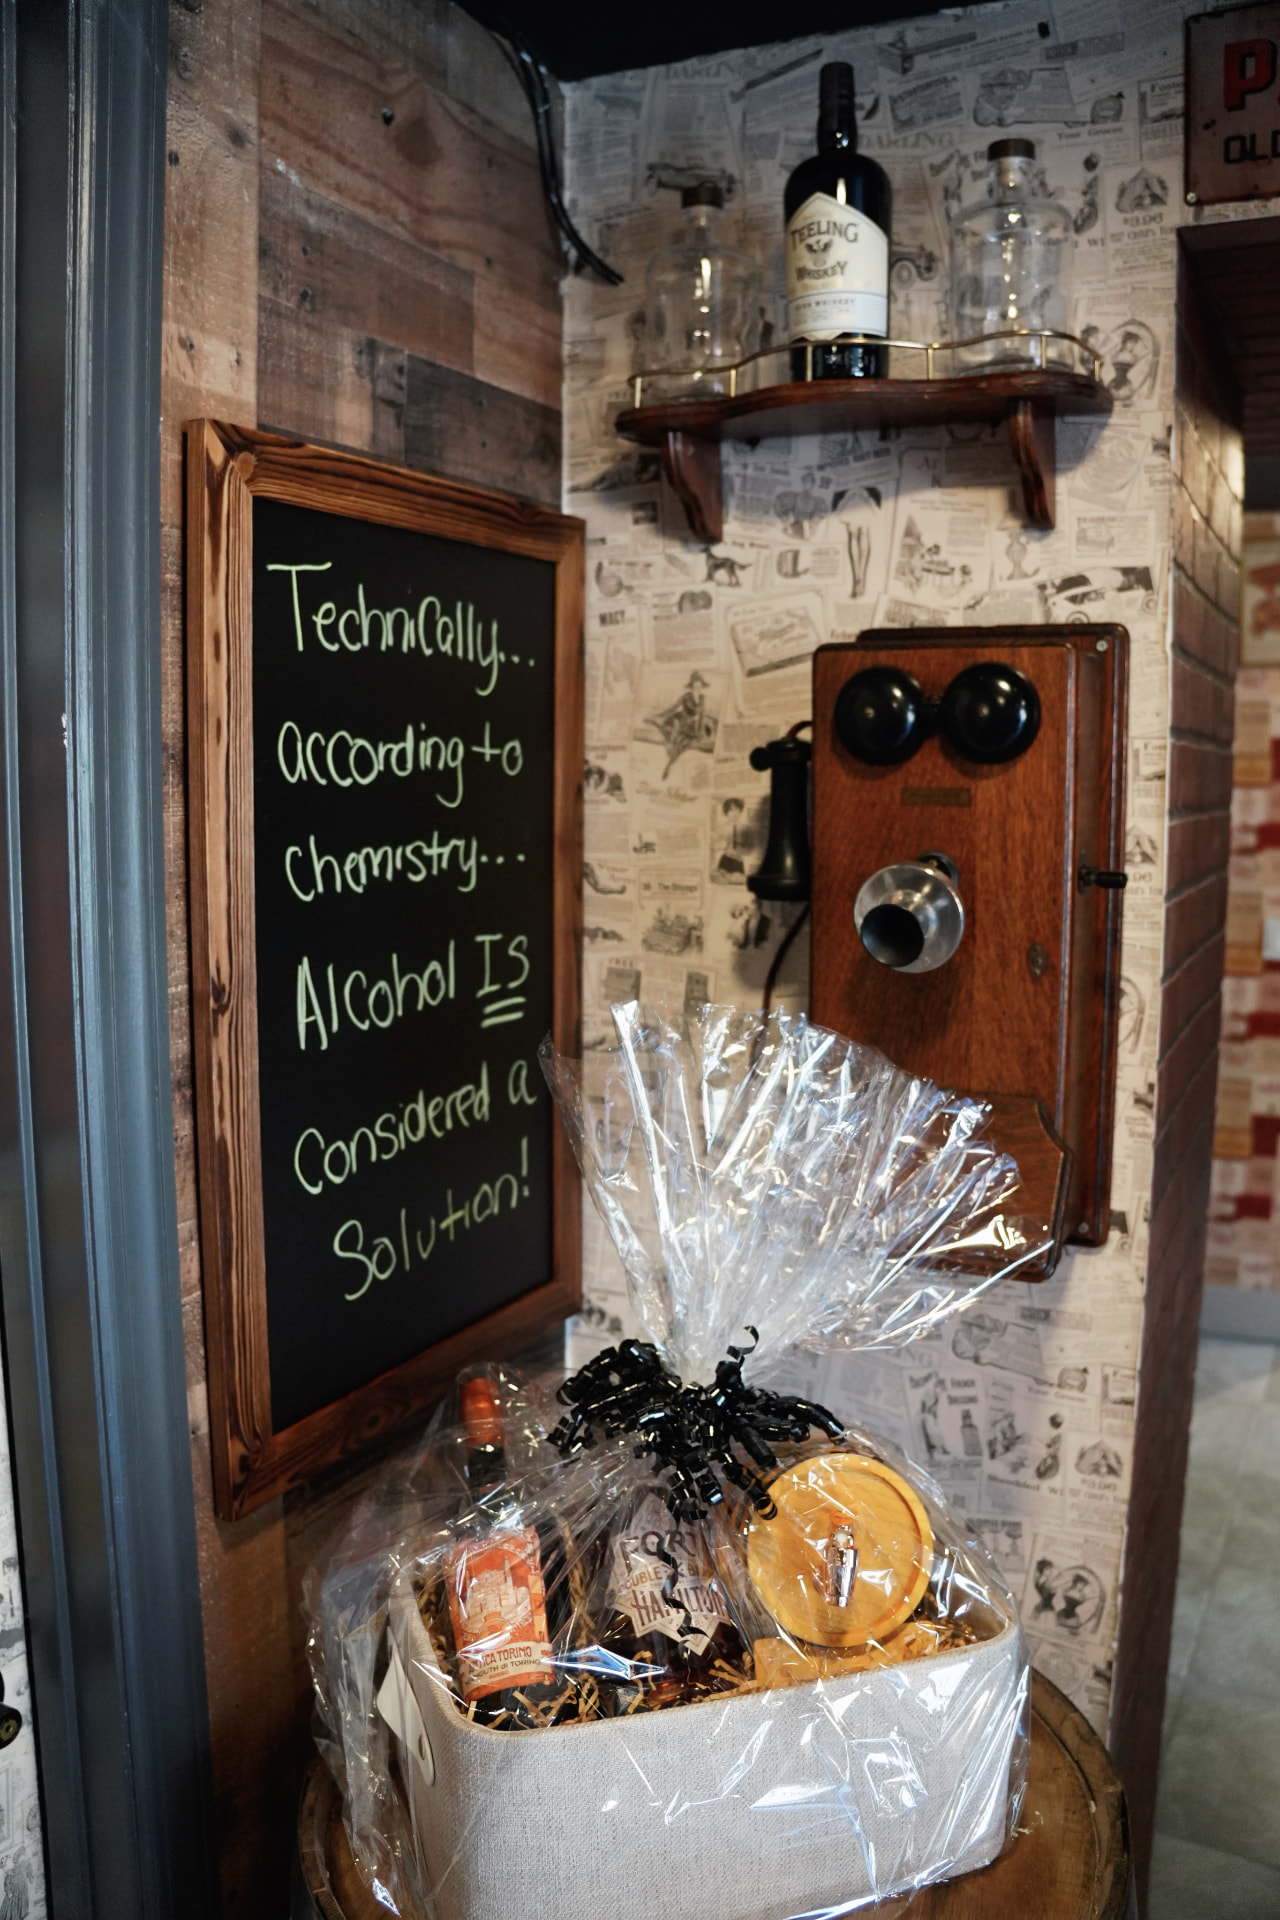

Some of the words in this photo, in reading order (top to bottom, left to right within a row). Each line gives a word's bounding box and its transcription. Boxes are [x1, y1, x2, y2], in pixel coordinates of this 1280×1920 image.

[1223, 38, 1280, 112] P
[790, 220, 859, 251] TEELING
[795, 261, 848, 282] WHISKEY
[471, 721, 523, 776] to
[297, 939, 455, 1051] Alcohol
[294, 1060, 490, 1195] Considered
[508, 1060, 537, 1105] a
[333, 1136, 530, 1301] Solution!
[630, 1584, 727, 1627] HAILTON
[496, 1646, 532, 1662] TORINO
[501, 1662, 509, 1670] di
[510, 1658, 540, 1667] TORINO
